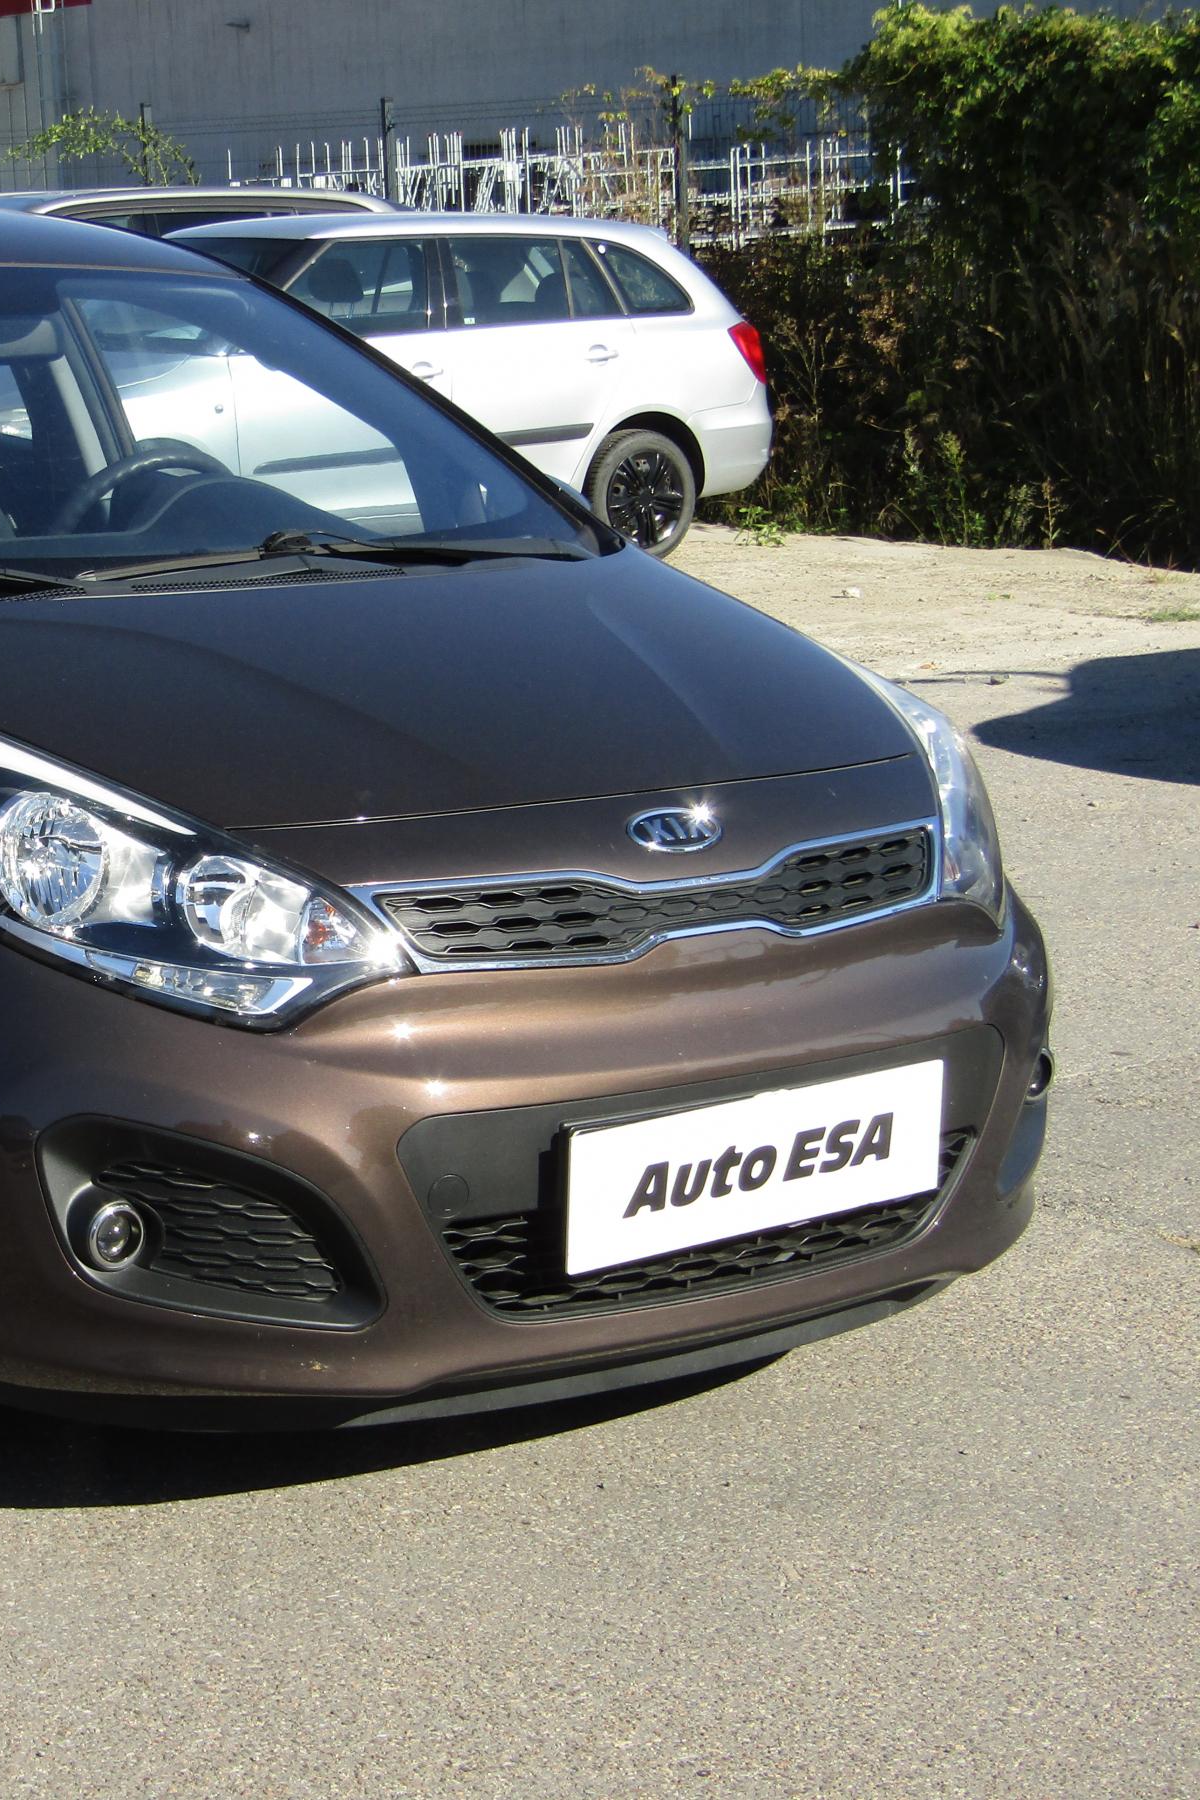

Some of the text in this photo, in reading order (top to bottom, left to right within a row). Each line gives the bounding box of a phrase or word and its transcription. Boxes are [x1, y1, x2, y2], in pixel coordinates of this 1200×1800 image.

[639, 816, 713, 844] KIA
[622, 1112, 894, 1218] Auto ESA
